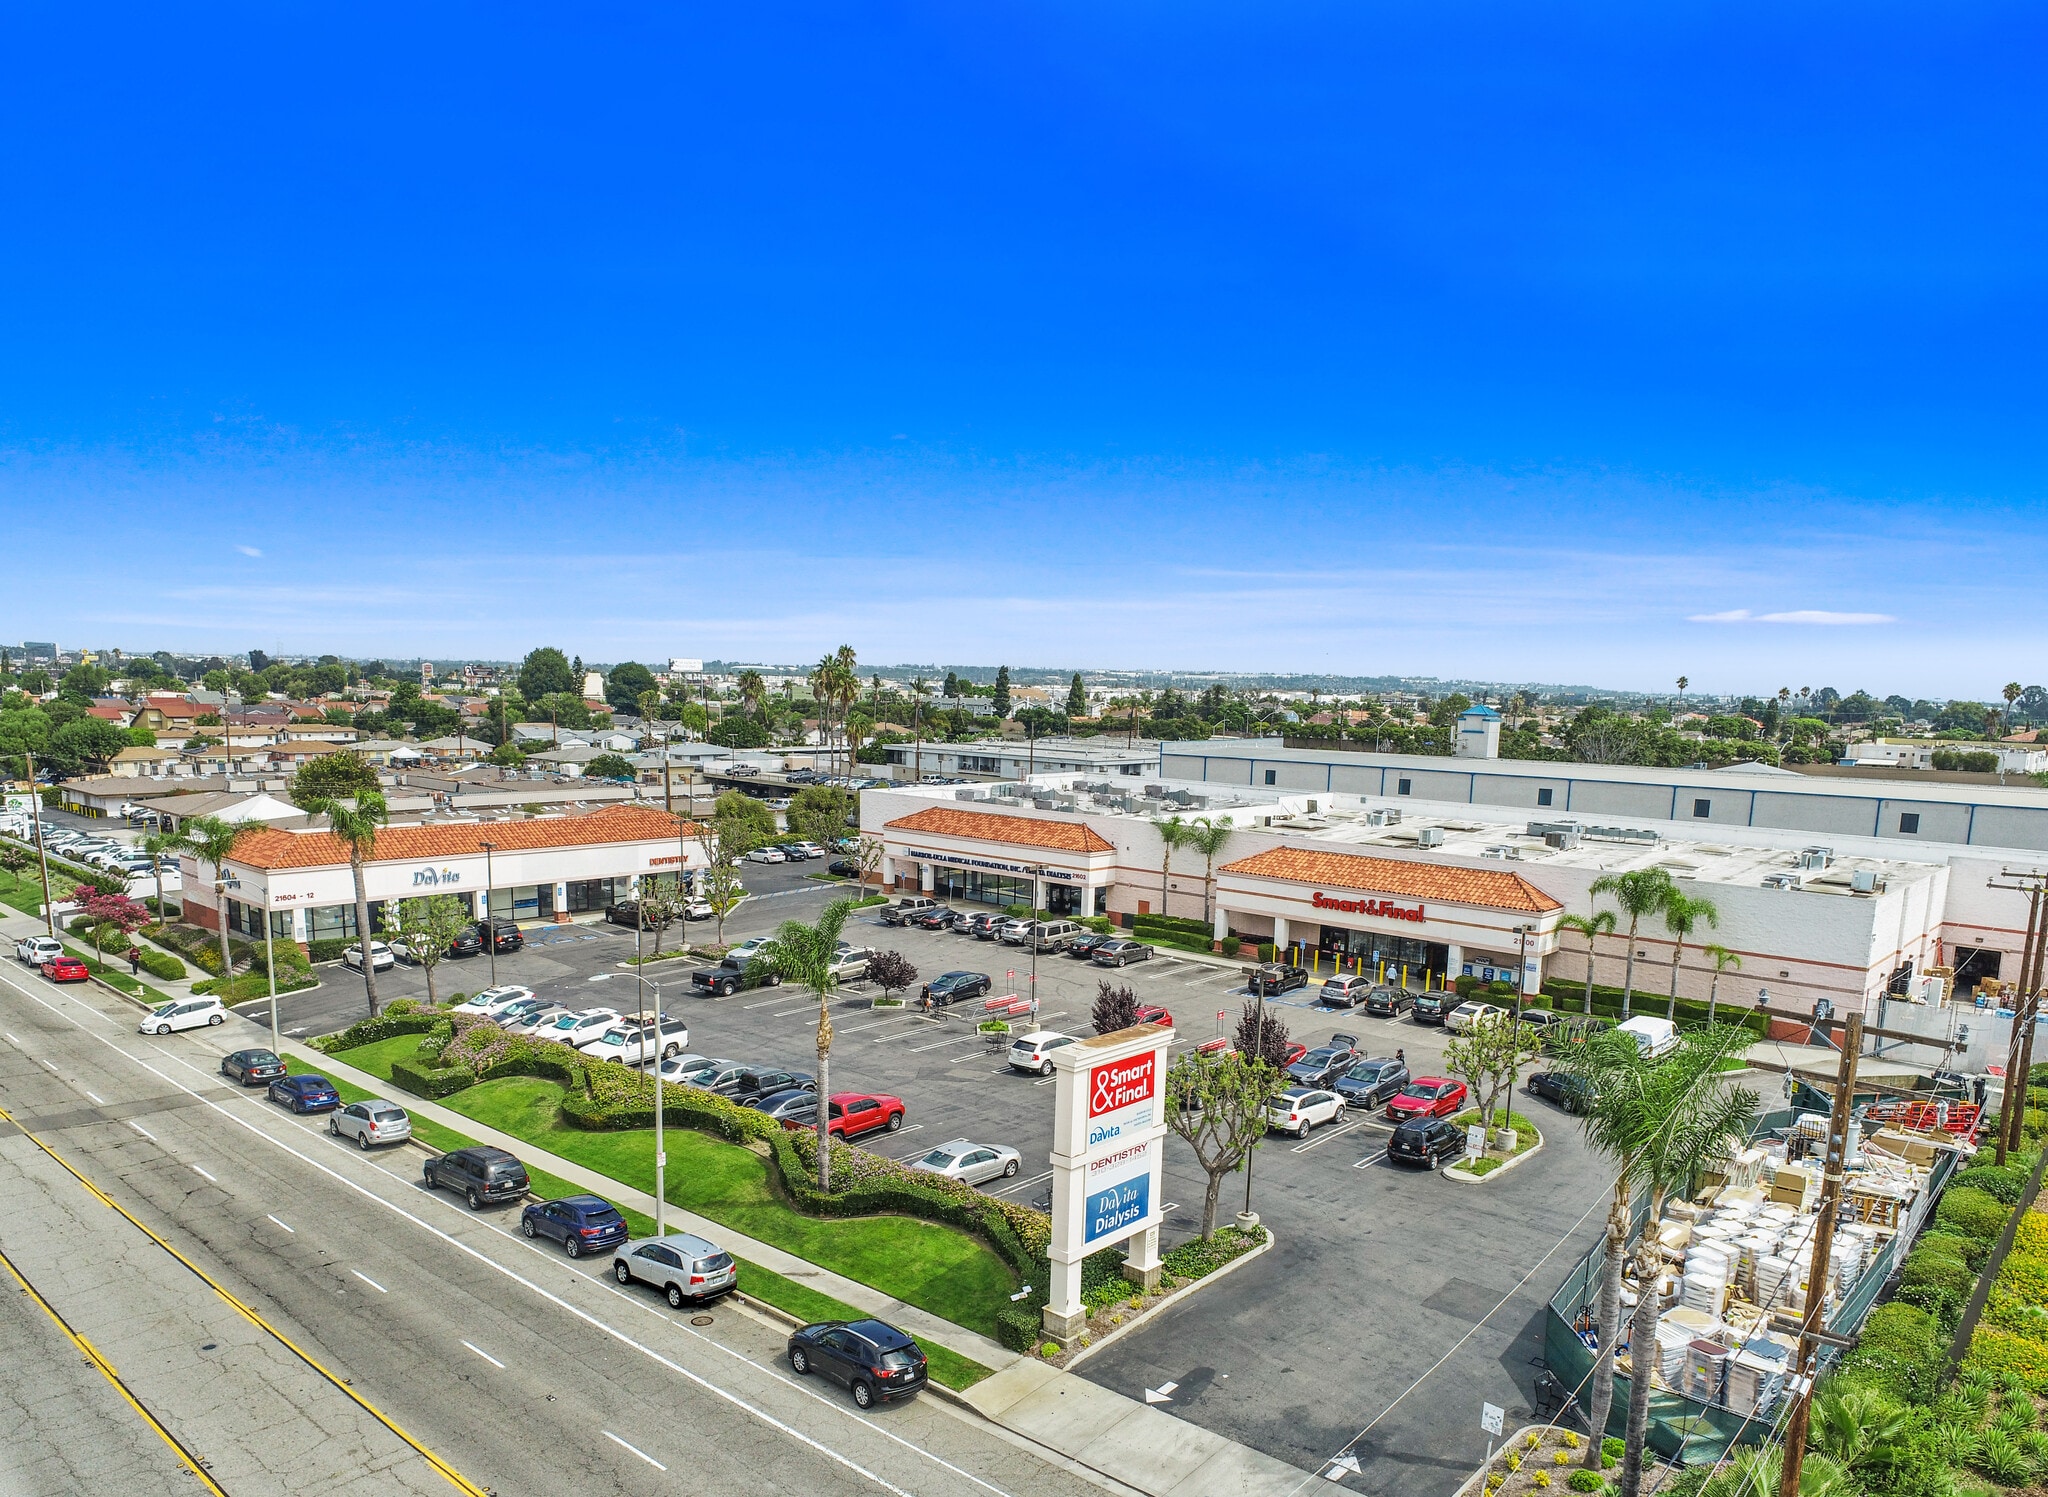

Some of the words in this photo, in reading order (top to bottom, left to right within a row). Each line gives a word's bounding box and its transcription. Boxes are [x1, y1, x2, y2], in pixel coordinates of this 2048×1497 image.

[412, 866, 460, 886] DaVita
[911, 850, 947, 862] HARBOR-UCLA
[948, 855, 970, 865] MEDICAL
[1046, 870, 1072, 880] DIALYSIS
[1513, 937, 1534, 947] 2100
[1110, 1059, 1152, 1087] Smart
[1091, 1142, 1148, 1171] DENTISTRY
[1099, 1186, 1139, 1214] DaVita
[1095, 1204, 1140, 1234] Dialysis
